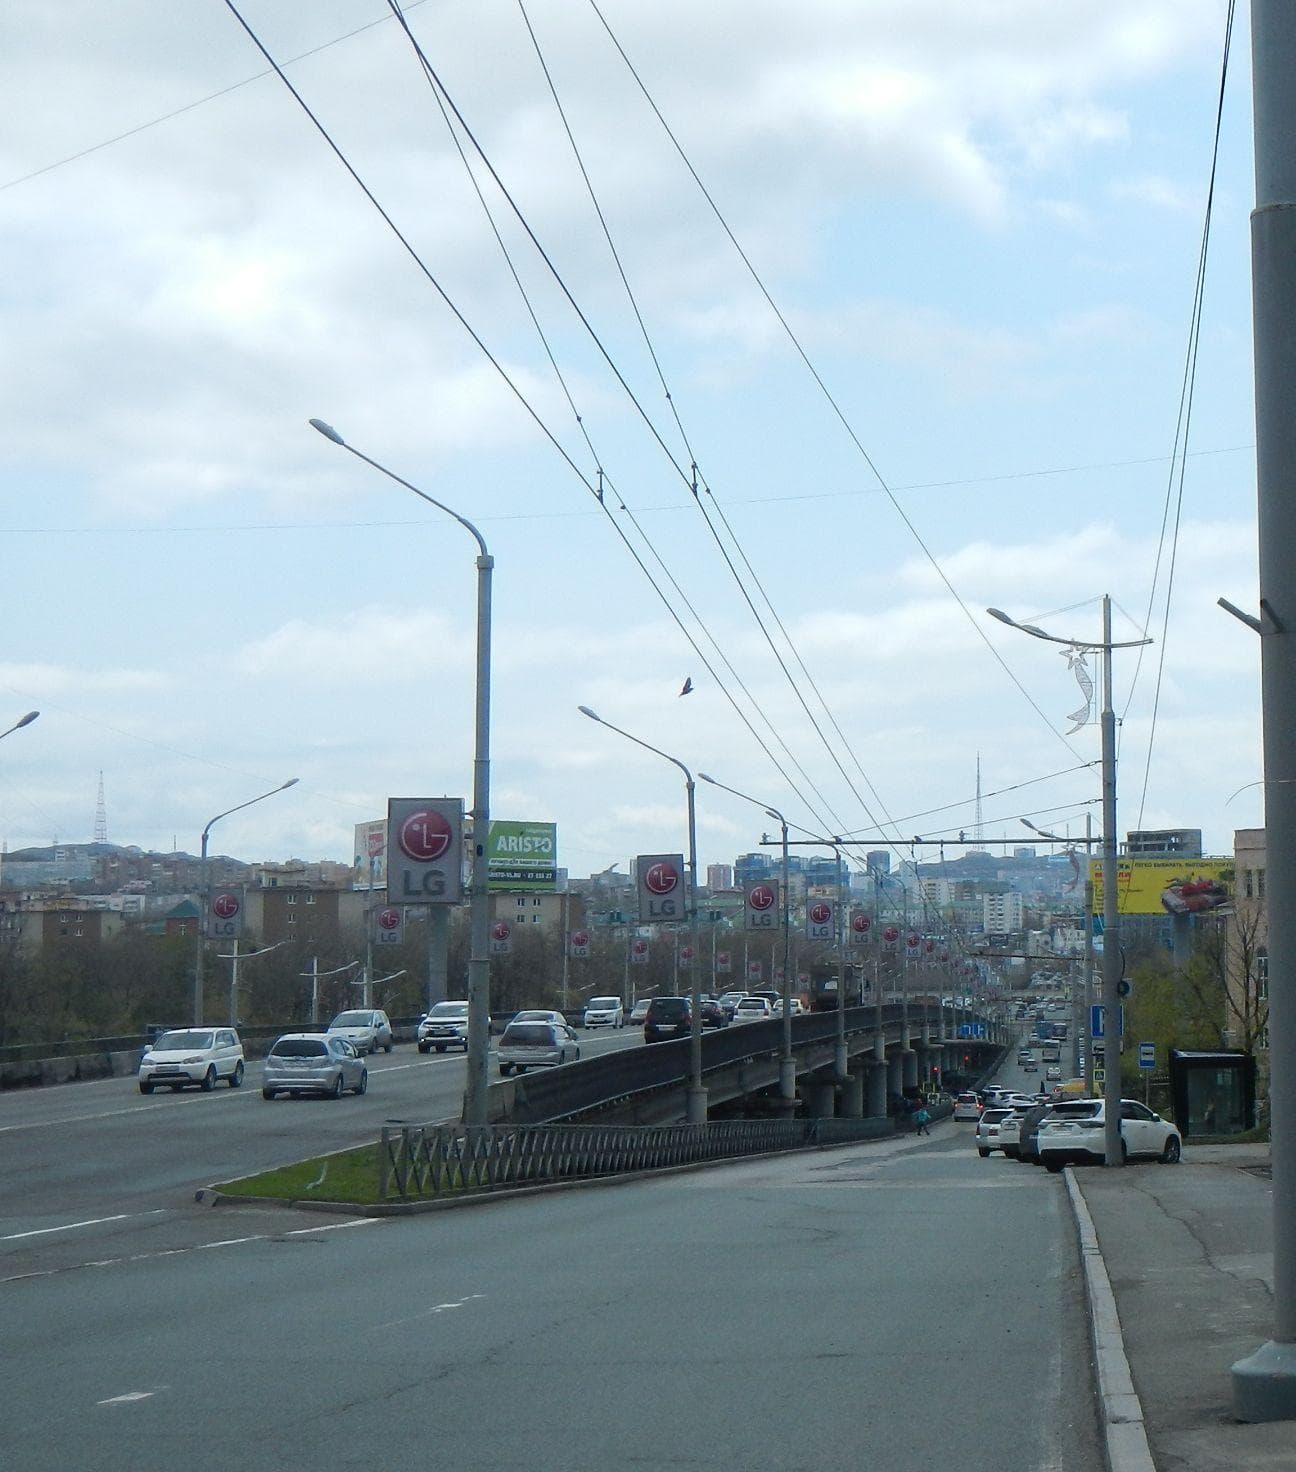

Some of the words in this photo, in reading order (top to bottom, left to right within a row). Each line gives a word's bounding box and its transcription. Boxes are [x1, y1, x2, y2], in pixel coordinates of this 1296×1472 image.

[496, 835, 553, 853] ARISTO
[403, 869, 446, 896] LG
[649, 899, 676, 916] LG
[752, 914, 771, 926] LG
[215, 923, 234, 935] LG
[813, 926, 829, 937] LG
[381, 932, 397, 943] LG
[854, 934, 868, 943] LG
